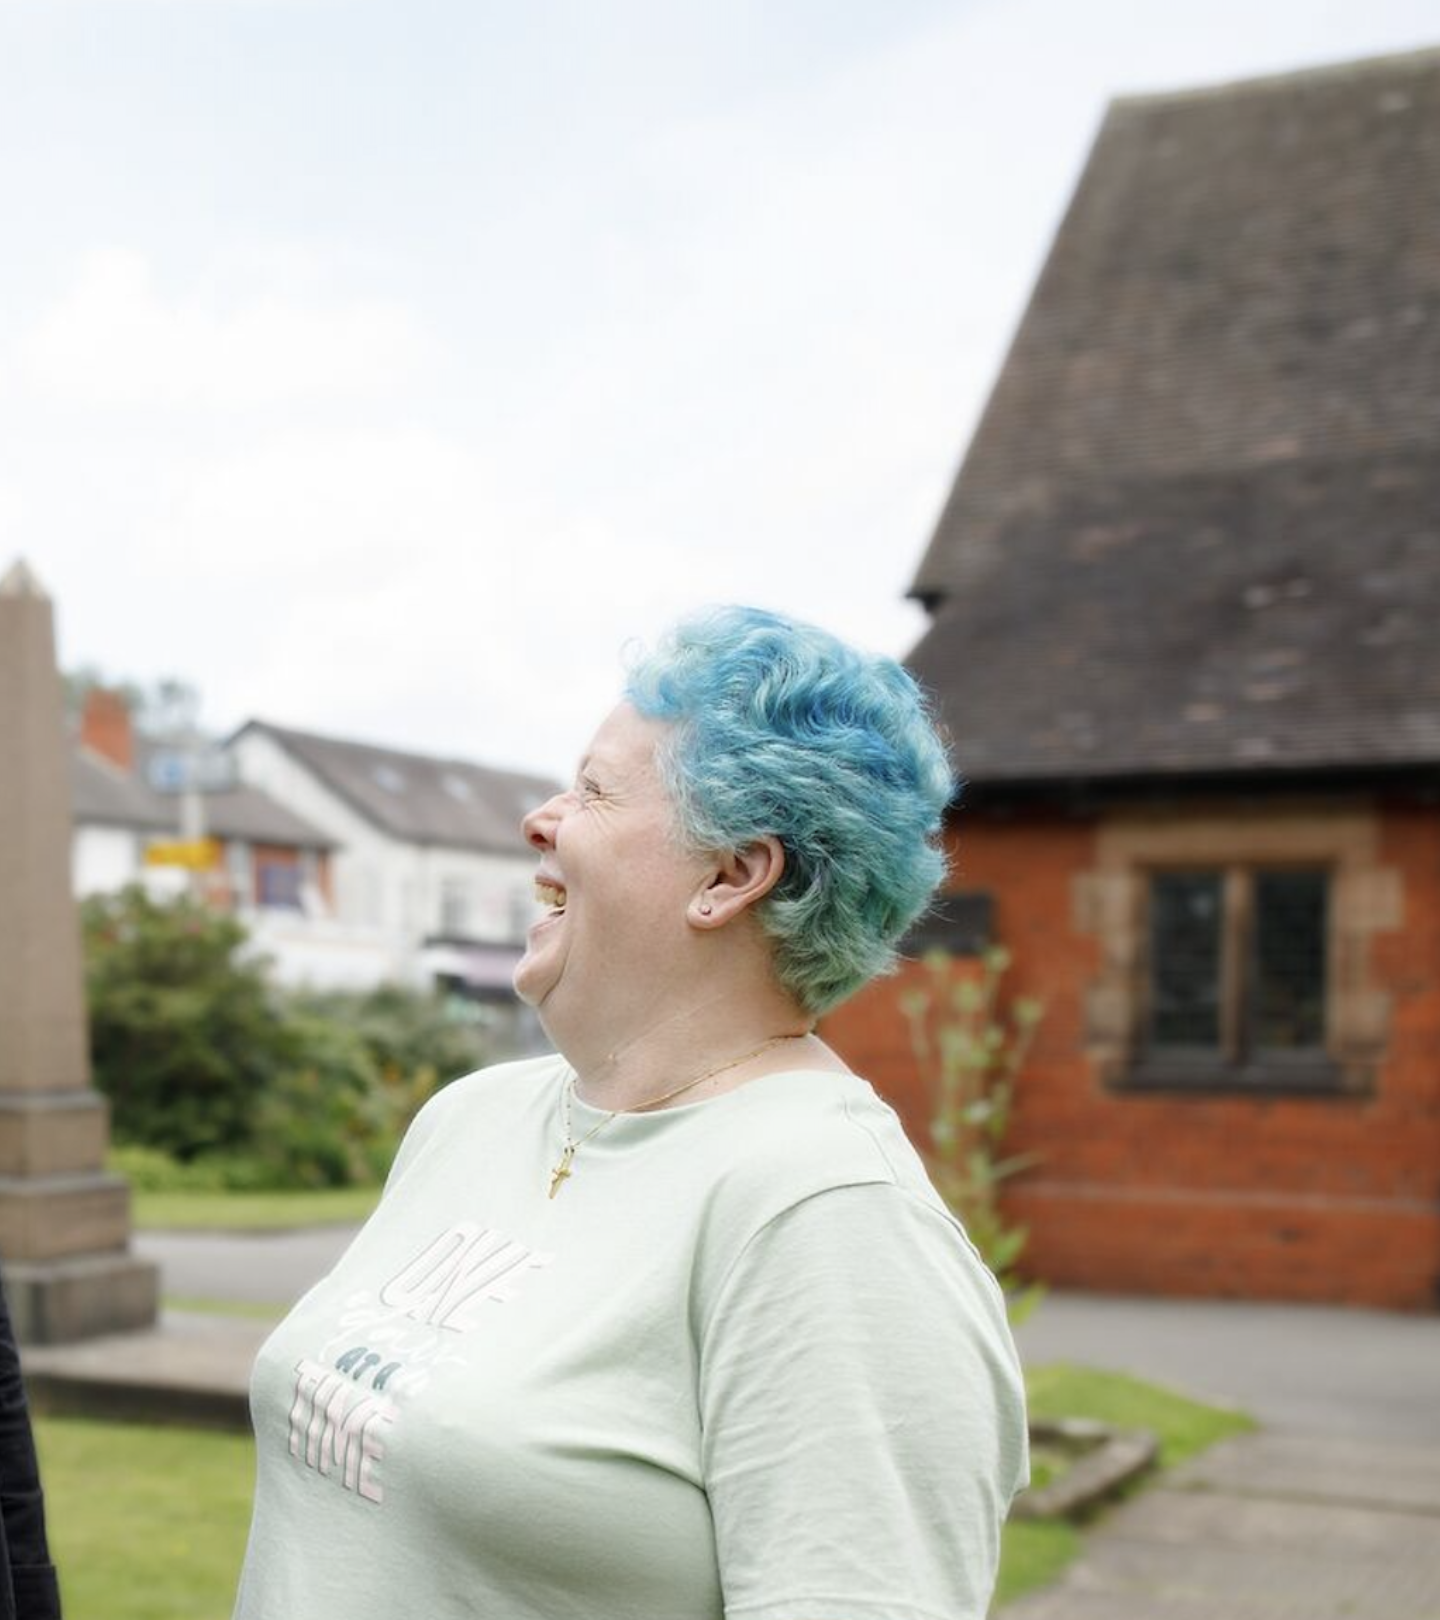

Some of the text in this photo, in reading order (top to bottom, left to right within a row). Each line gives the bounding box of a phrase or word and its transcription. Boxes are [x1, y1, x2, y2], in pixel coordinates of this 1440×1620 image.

[379, 1221, 553, 1333] ONE
[335, 1347, 402, 1391] AT A
[288, 1359, 399, 1506] TIME
